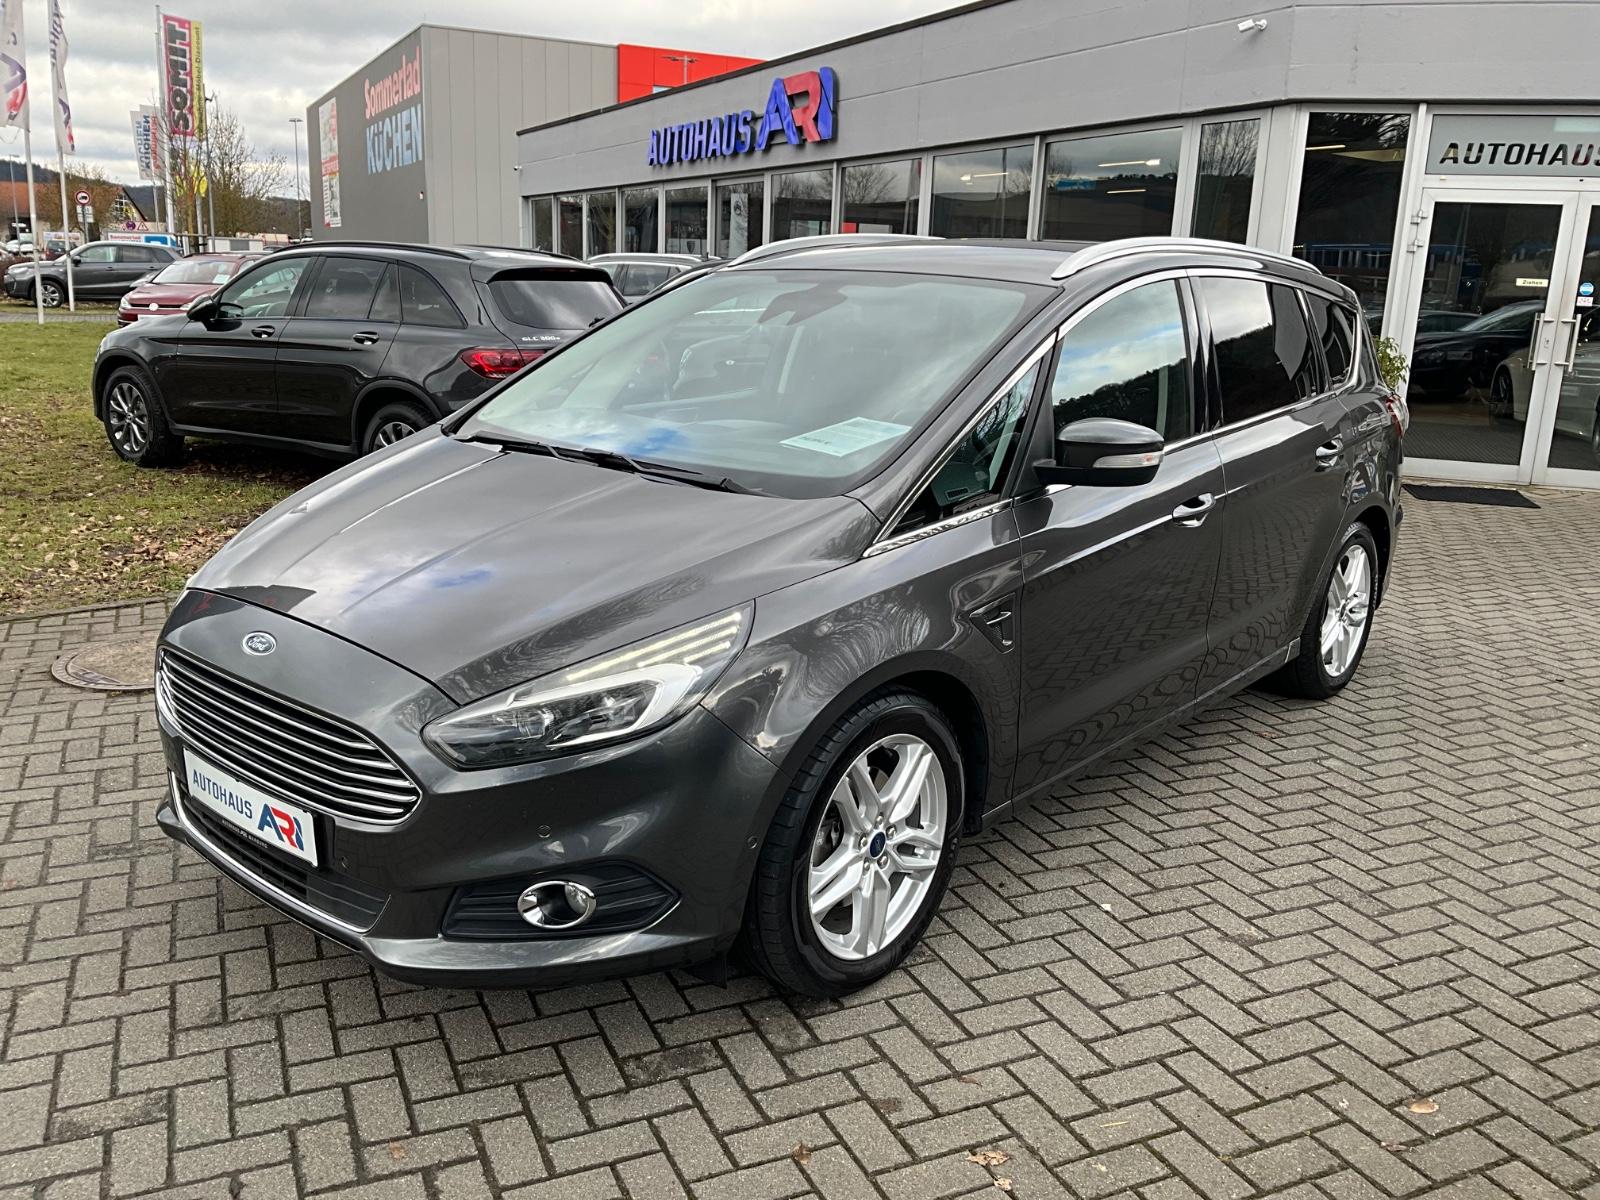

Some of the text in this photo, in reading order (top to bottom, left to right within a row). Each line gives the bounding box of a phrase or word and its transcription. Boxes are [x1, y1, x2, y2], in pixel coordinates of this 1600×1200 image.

[166, 21, 192, 131] SOMIT
[364, 46, 421, 119] Sommerlad
[648, 66, 839, 166] AUTOHAUS ARI
[366, 103, 423, 175] KÜCHEN
[192, 768, 305, 852] AUTOHAUS ARI
